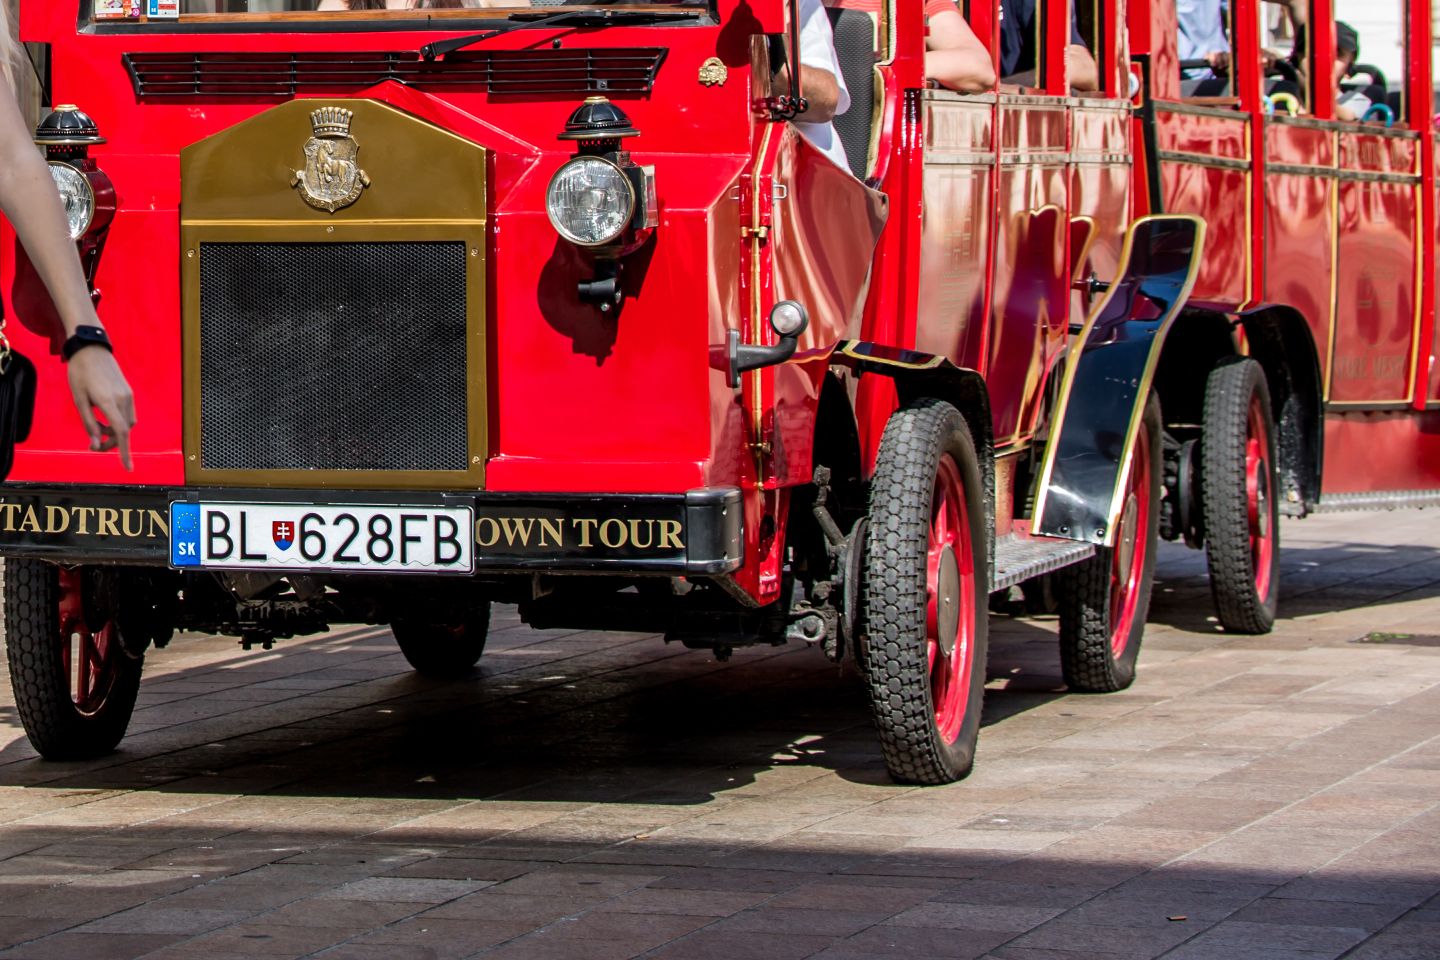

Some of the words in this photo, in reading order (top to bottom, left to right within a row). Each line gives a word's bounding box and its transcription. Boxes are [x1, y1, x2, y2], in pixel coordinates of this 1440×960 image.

[178, 542, 196, 556] SK
[207, 510, 267, 560] BL
[299, 512, 462, 564] 628FB
[475, 517, 565, 547] OWN
[572, 518, 685, 549] TOUR
